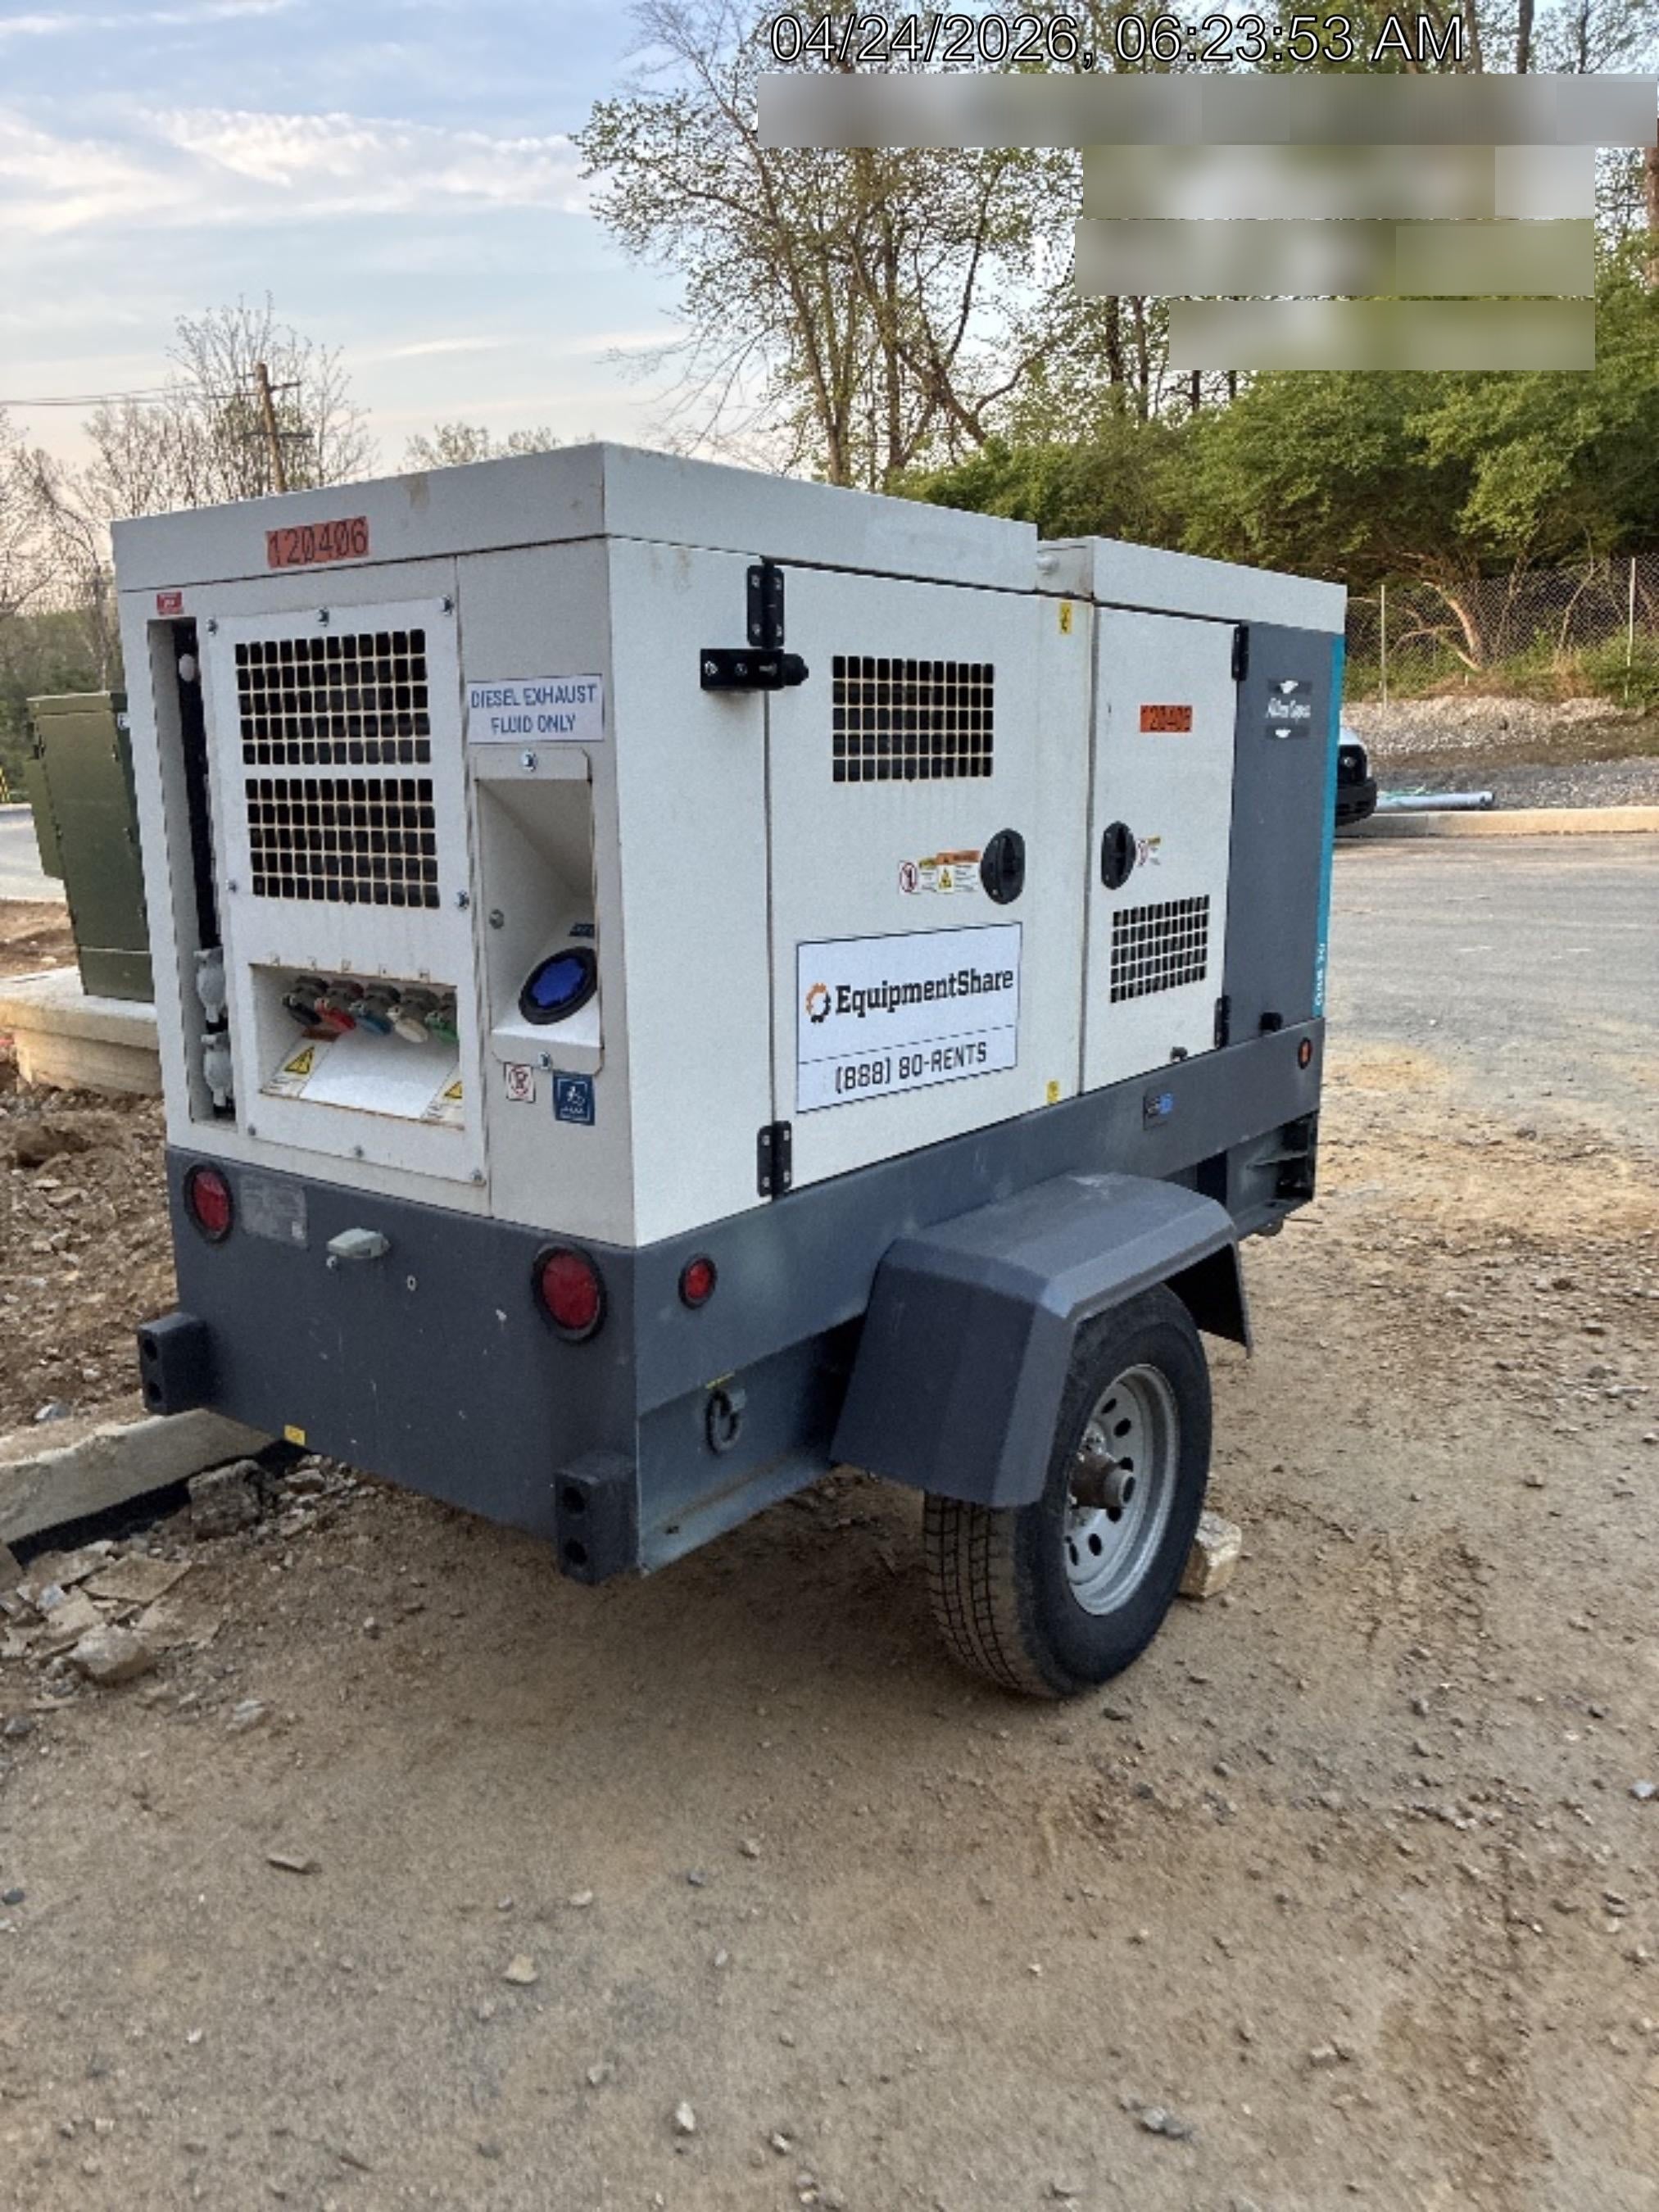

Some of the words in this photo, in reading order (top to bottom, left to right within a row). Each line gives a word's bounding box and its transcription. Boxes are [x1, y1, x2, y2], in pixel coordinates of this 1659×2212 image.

[269, 518, 368, 566] 120406
[471, 687, 521, 709] DIESEL
[523, 682, 597, 706] EXHAUST
[491, 714, 533, 735] FLUID
[537, 712, 576, 734] ONLY
[835, 968, 1013, 1018] EquipmentShare
[835, 1056, 891, 1095] (888)
[898, 1041, 987, 1081] 80-RENTS
